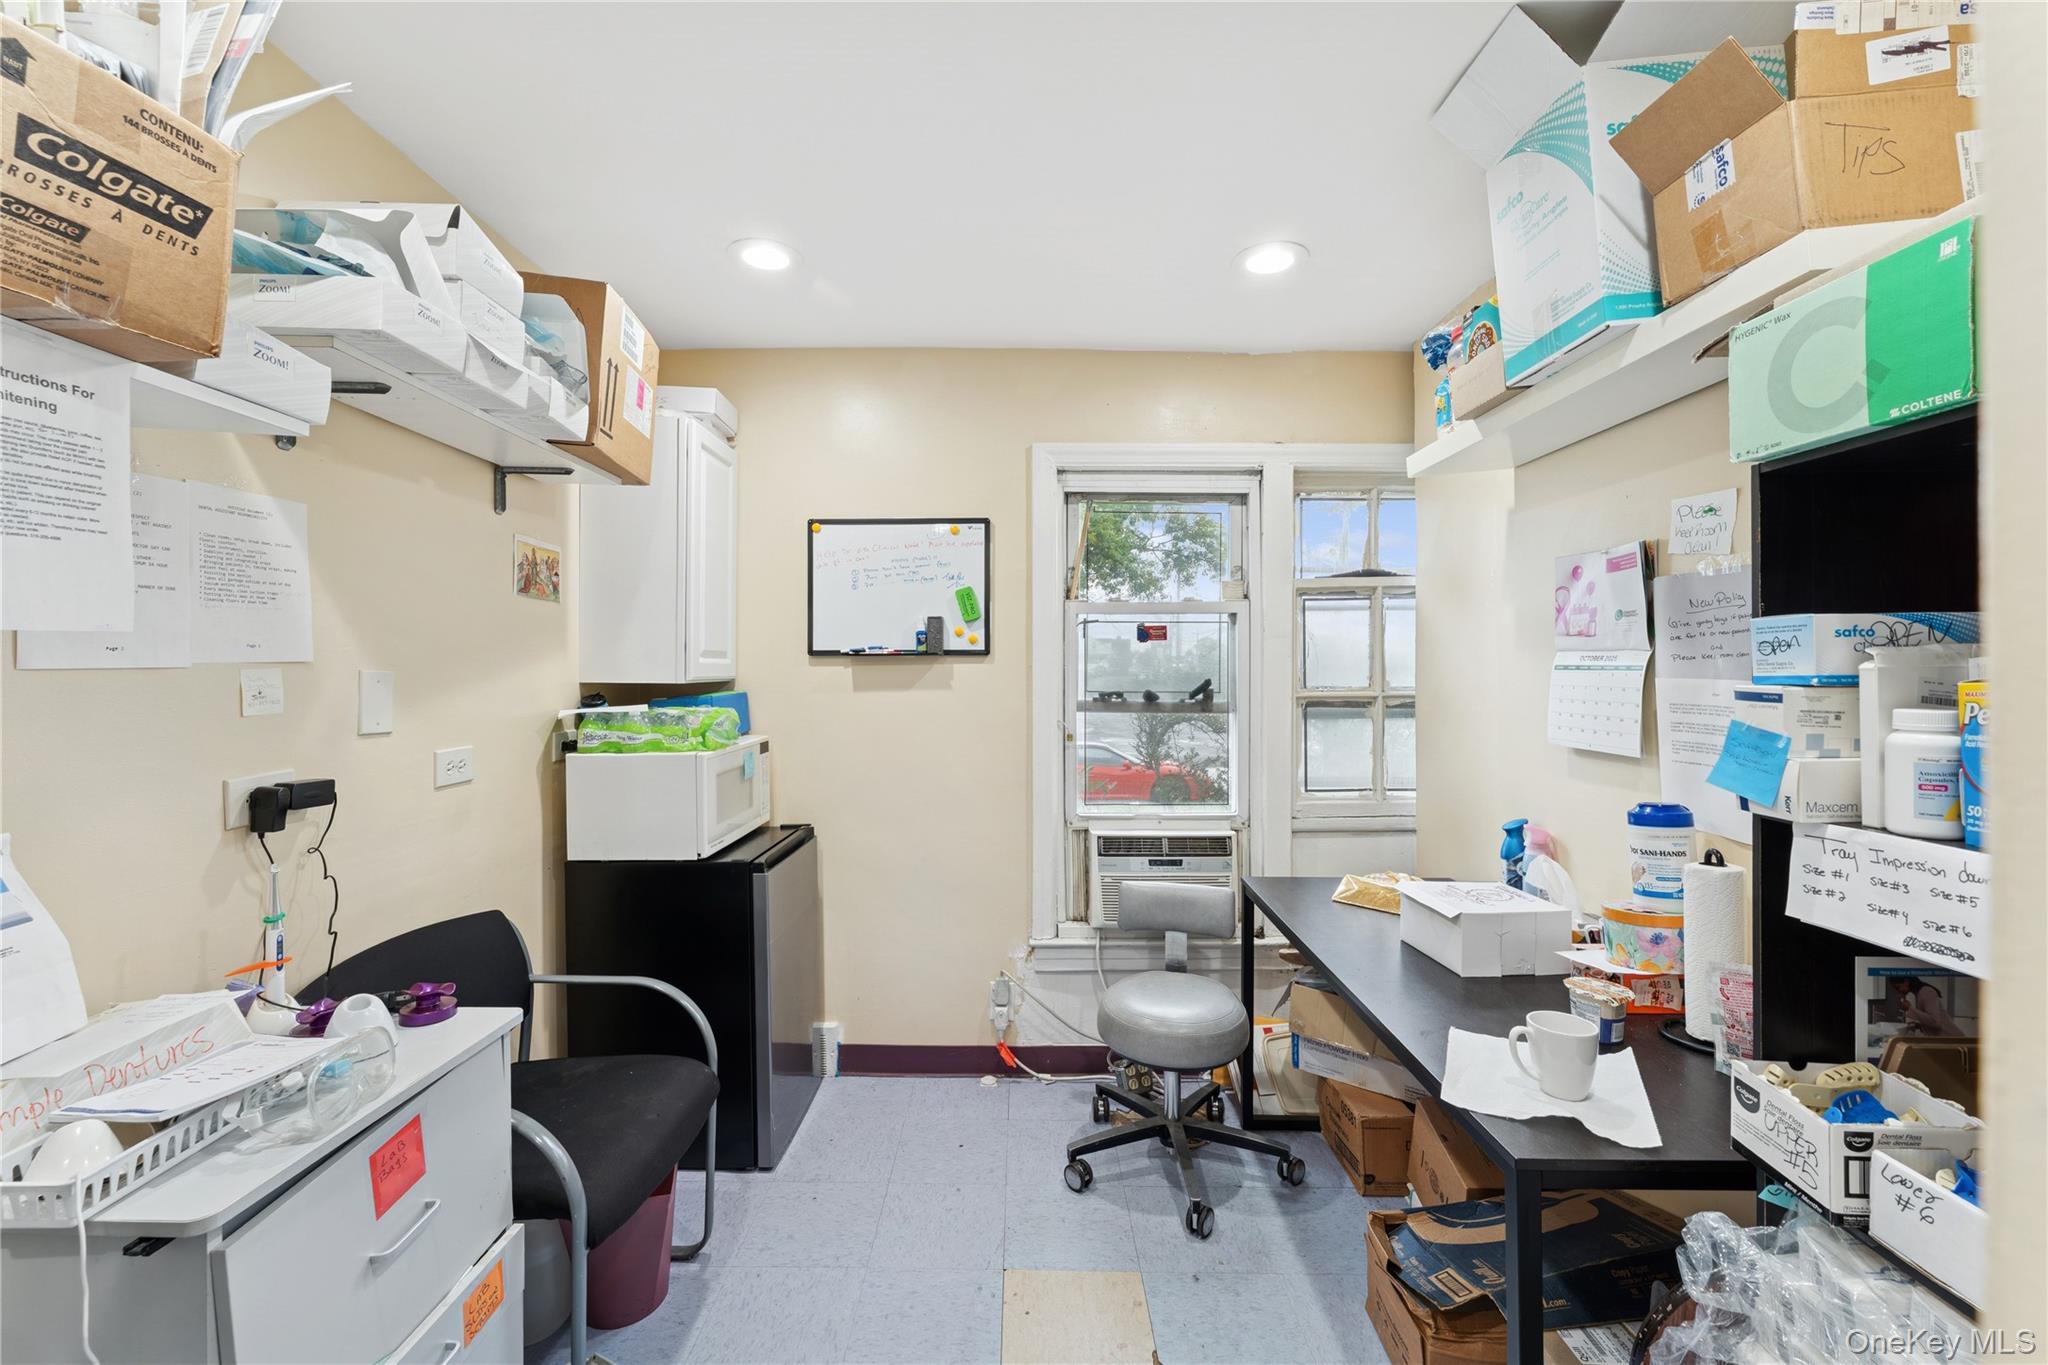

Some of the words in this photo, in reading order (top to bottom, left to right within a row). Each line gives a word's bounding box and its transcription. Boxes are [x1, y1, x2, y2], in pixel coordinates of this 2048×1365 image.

[122, 114, 140, 130] 144
[141, 126, 181, 153] BROSSES
[190, 154, 217, 174] DENTS
[140, 108, 204, 153] CONTENU:
[26, 131, 200, 225] Colgate
[0, 158, 93, 209] ROSSES
[142, 223, 200, 257] DENTS
[0, 196, 80, 237] Colgate
[1774, 312, 1792, 326] Wax
[71, 384, 96, 400] For
[1901, 388, 1962, 416] COLTENE
[1688, 597, 1713, 610] New
[1834, 624, 1876, 638] safco
[1783, 795, 1791, 815] Kerr
[1805, 801, 1859, 814] Maxcem
[1639, 847, 1688, 858] SANI-HANDS
[1804, 834, 1859, 873] Tray
[1868, 847, 1946, 879] Impression
[1956, 893, 1980, 909] #5
[1949, 924, 1973, 938] #6
[1766, 1099, 1788, 1119] Dental
[1788, 1112, 1805, 1129] Floss
[1764, 1112, 1819, 1169] UPPER
[1881, 1133, 1903, 1141] Dental
[1783, 1149, 1818, 1191] #5
[1881, 1163, 1944, 1205] Lower
[1894, 1193, 1935, 1225] #6
